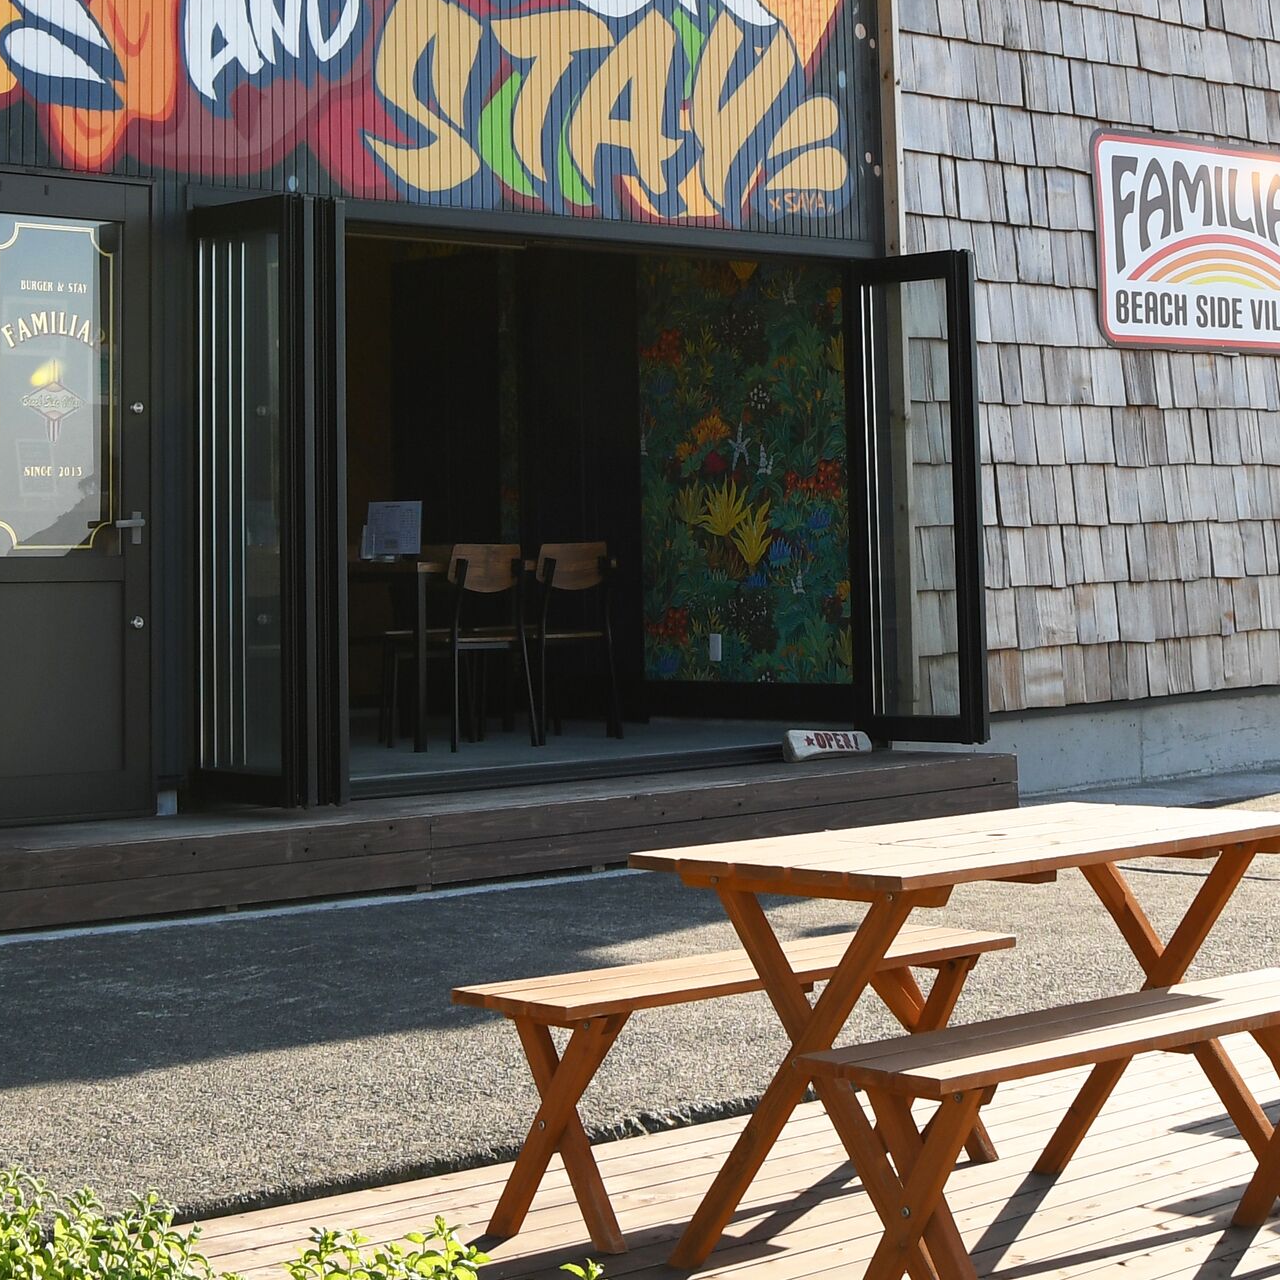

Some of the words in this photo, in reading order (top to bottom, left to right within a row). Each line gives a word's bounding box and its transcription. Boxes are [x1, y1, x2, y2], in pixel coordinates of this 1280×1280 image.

[20, 279, 54, 292] BURGER
[57, 281, 65, 292] &
[68, 282, 88, 294] STAY
[1115, 288, 1188, 326] BEACH
[1196, 293, 1244, 329] SIDE
[23, 465, 53, 477] SINCE
[58, 465, 83, 477] 2013
[813, 731, 861, 751] OPEN!
